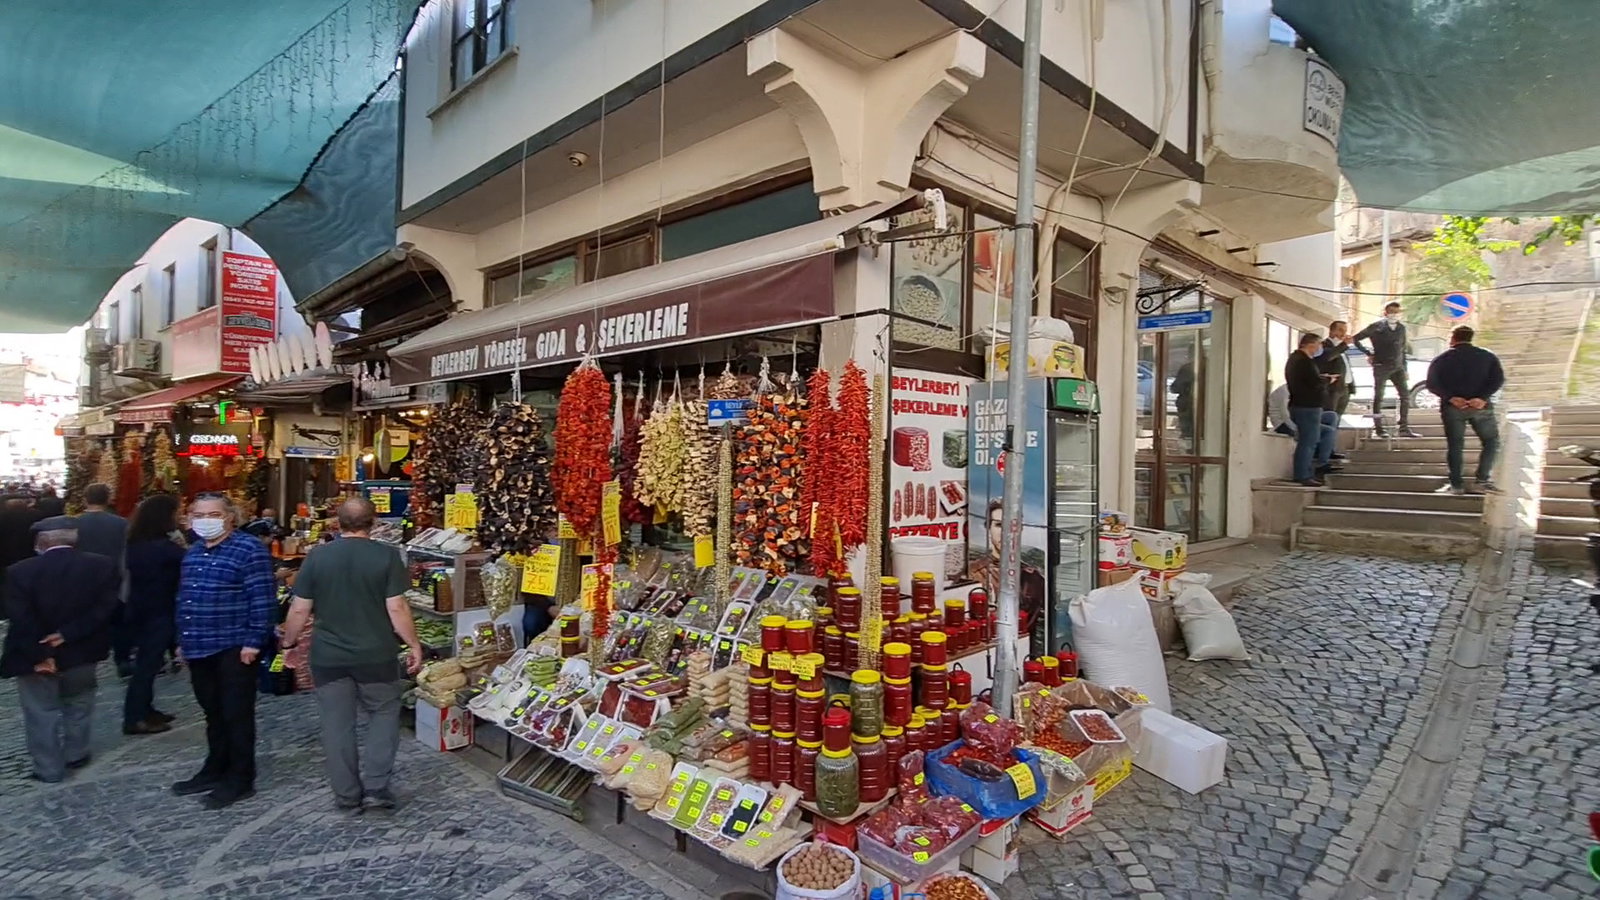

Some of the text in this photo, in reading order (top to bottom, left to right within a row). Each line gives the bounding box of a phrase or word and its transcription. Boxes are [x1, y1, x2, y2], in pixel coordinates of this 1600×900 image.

[484, 337, 527, 369] YÖRESEL
[536, 328, 567, 360] GIDA
[575, 323, 586, 353] &
[598, 302, 689, 352] ŞEKERLEME
[891, 376, 960, 396] BEYLERBEYİ
[892, 398, 958, 417] ŞEKERLEME
